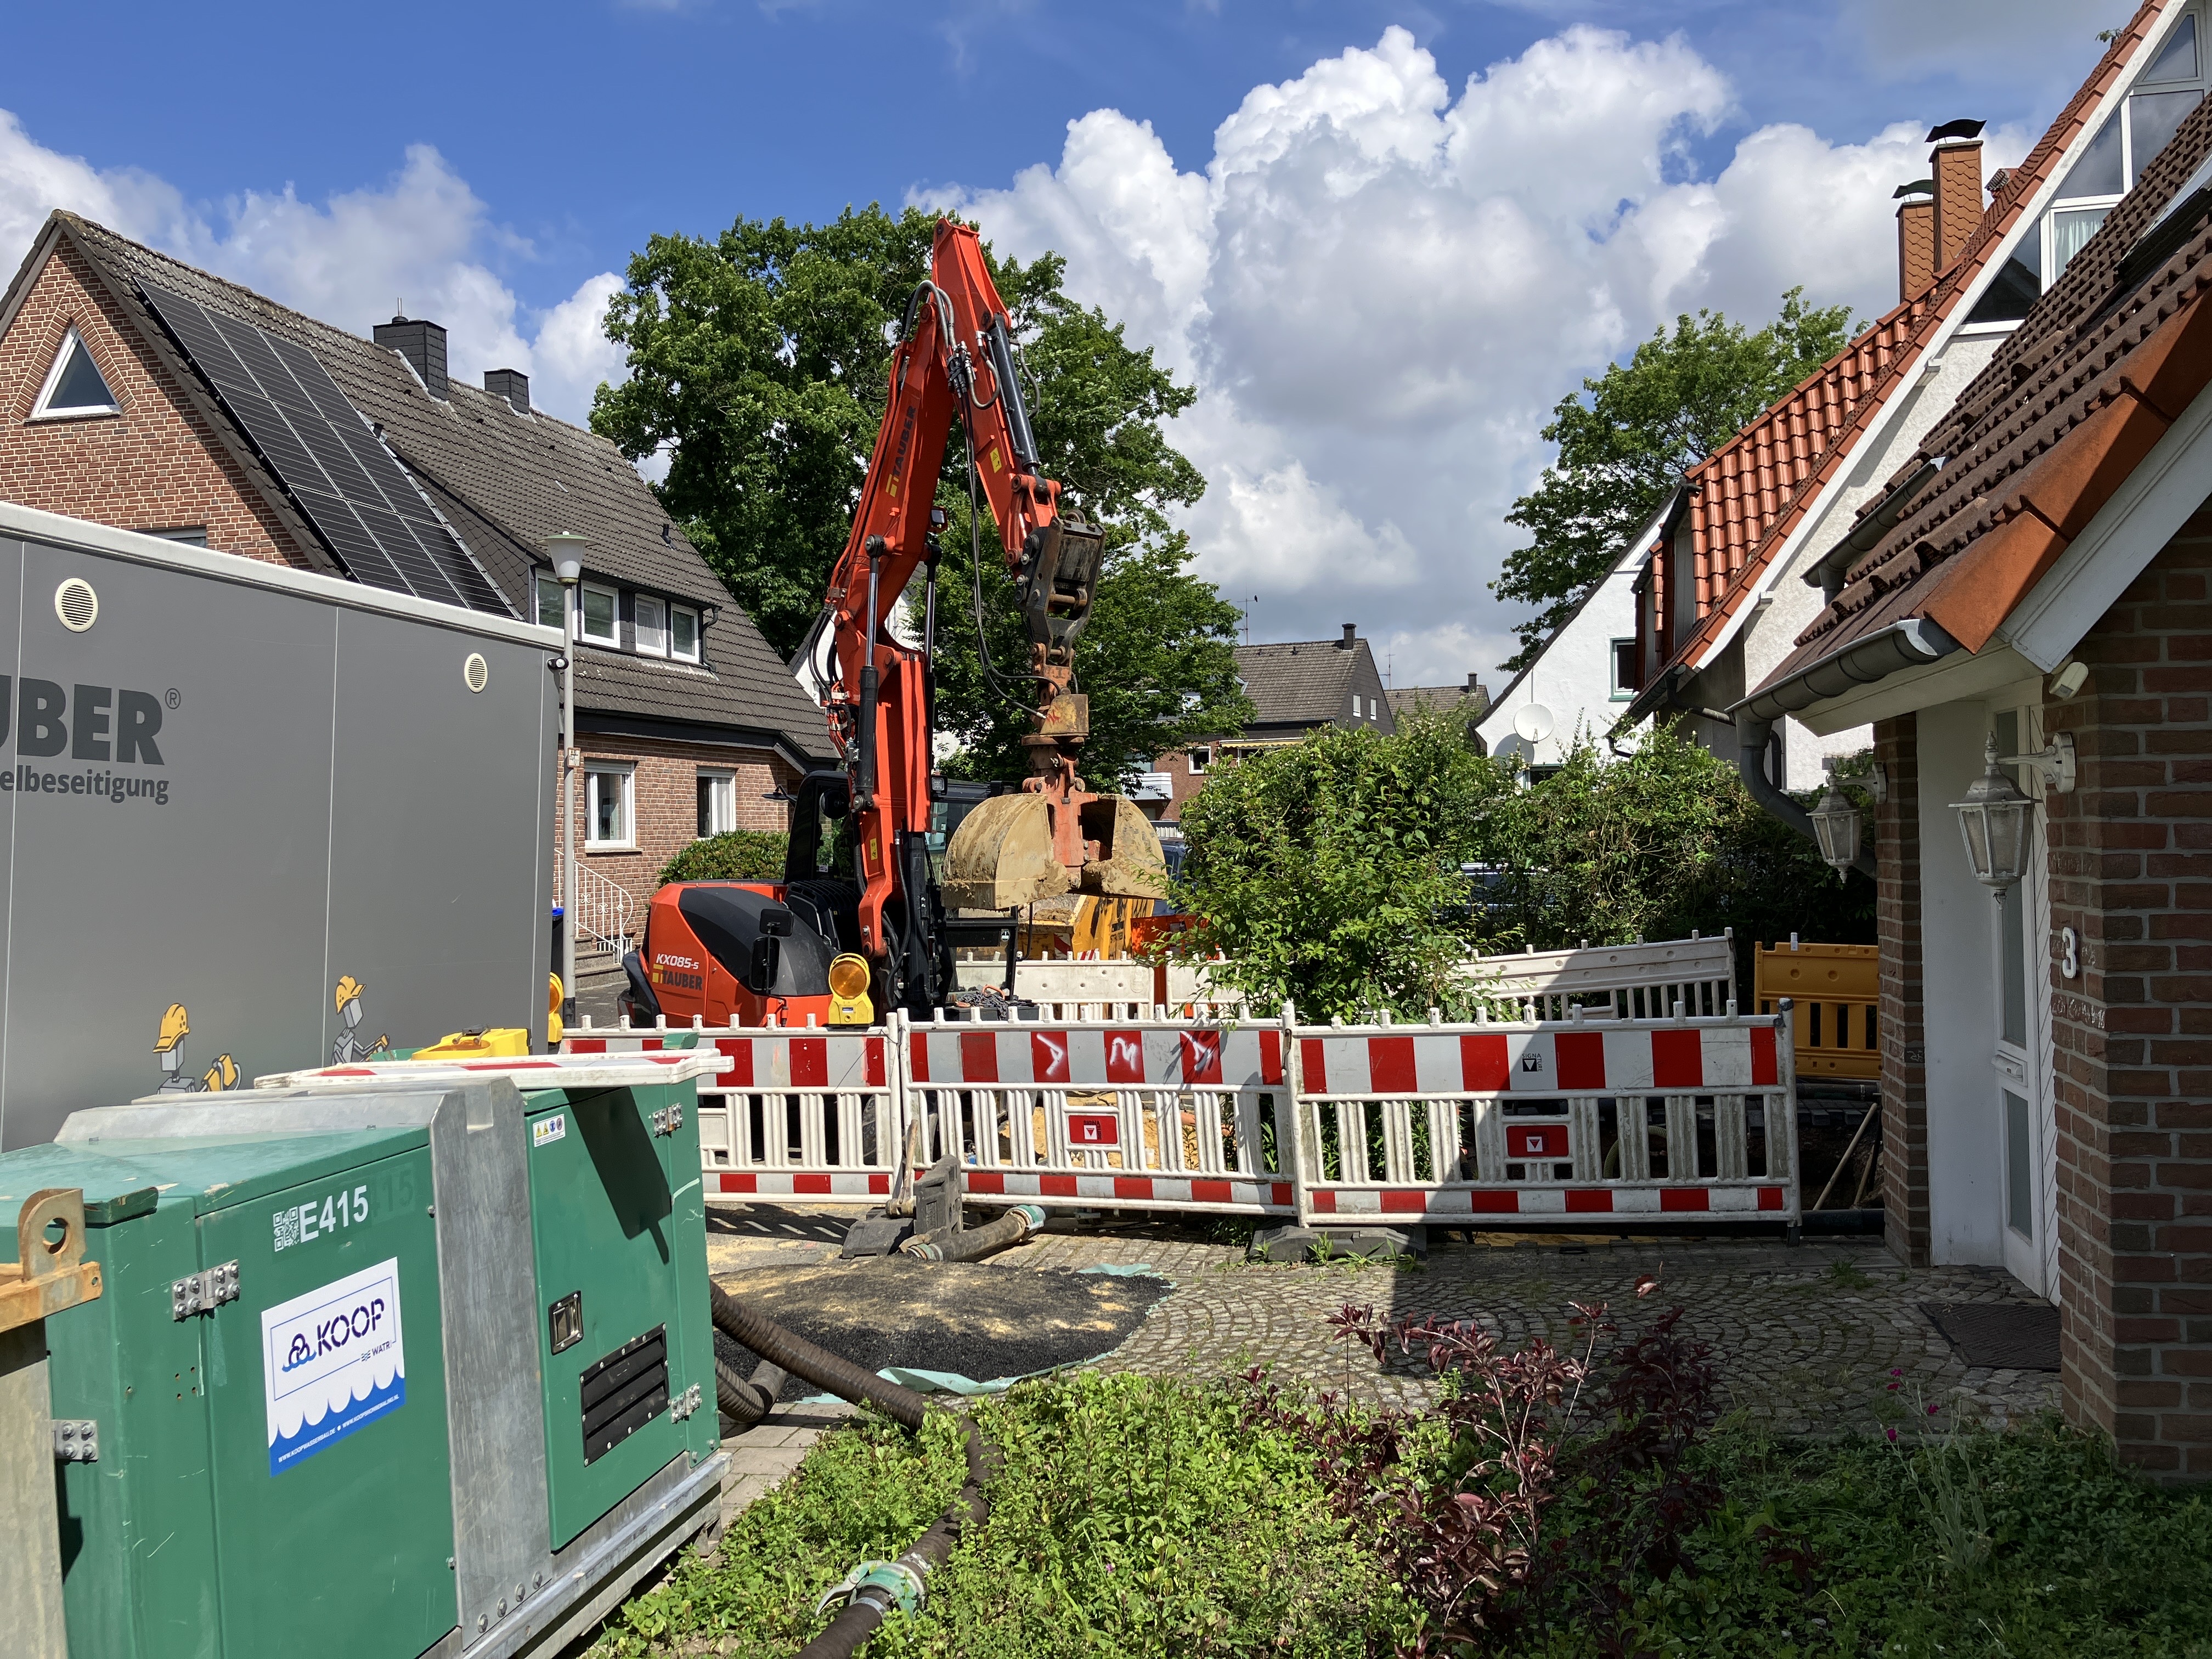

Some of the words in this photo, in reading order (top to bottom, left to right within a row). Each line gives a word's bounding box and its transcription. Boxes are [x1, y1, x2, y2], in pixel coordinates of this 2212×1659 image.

[893, 405, 916, 476] TAUBER
[0, 765, 169, 805] elbeseitigung
[656, 953, 699, 970] KX085-5
[2062, 927, 2076, 979] 3
[662, 969, 702, 991] TAUBER
[299, 1185, 369, 1243] E415
[317, 1298, 385, 1356] KOOP
